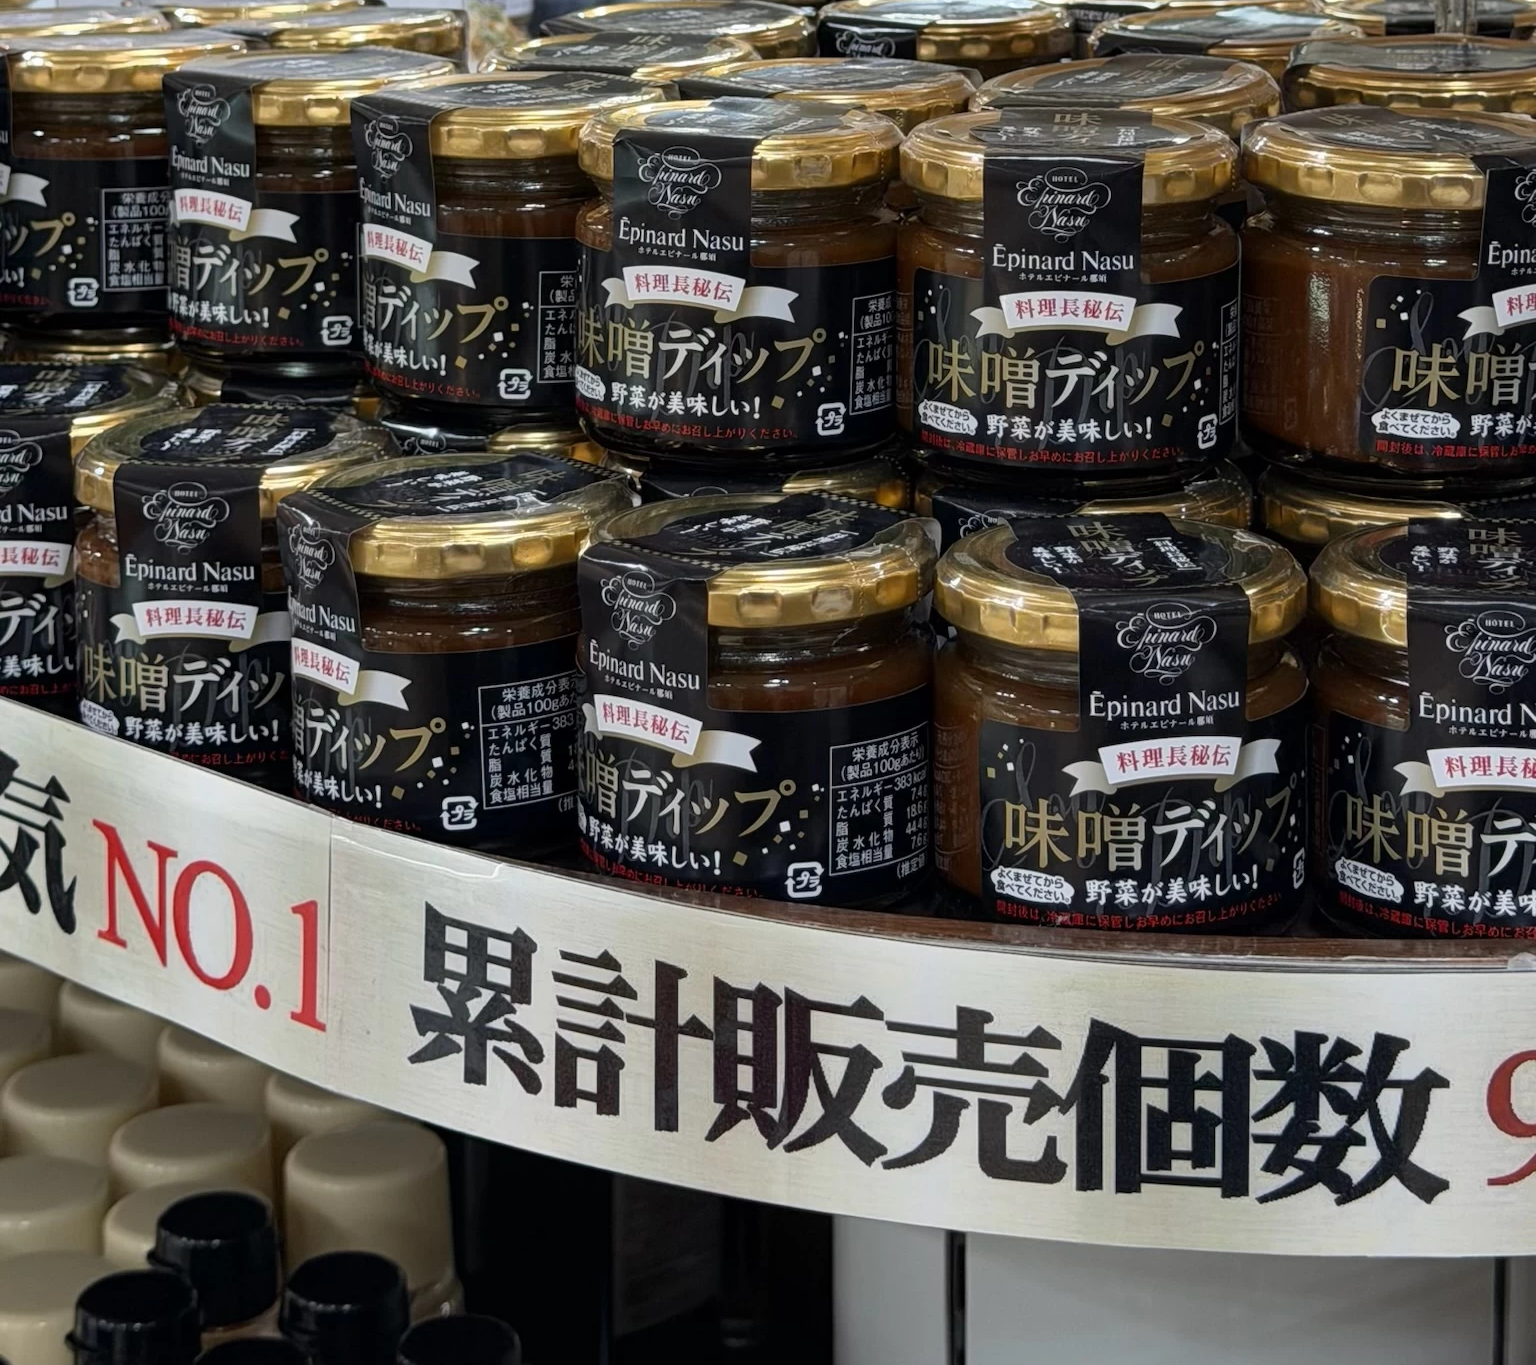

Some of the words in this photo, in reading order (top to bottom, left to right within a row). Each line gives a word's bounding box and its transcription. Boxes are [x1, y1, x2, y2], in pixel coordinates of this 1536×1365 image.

[211, 156, 250, 178] Nasu
[1051, 175, 1079, 184] HOTEL
[179, 195, 244, 223] 料理長秘伝
[394, 192, 431, 218] Nasu
[1028, 204, 1089, 232] Nasu
[367, 229, 425, 264] 料理長秘伝
[692, 229, 744, 252] Nasu
[1081, 250, 1134, 271] Nasu
[633, 272, 734, 303] 料理長秘伝
[1015, 298, 1125, 323] 料理長秘伝
[329, 324, 350, 339] プラ
[577, 310, 827, 385] 味噌ディップ
[507, 376, 529, 393] プラ
[928, 339, 1206, 410] 味噌ディップ
[1391, 342, 1536, 408] 味噌
[611, 381, 761, 420] 野菜が美味しい!
[824, 411, 844, 427] プラ
[986, 414, 1153, 444] 野菜が美味しい!
[1378, 421, 1456, 437] 食べてください。
[1380, 410, 1451, 425] よくまぜてから
[1470, 411, 1536, 438] 野菜が
[18, 503, 68, 524] Nasu
[203, 561, 255, 581] Nasu
[145, 606, 248, 630] 料理長秘伝
[319, 605, 356, 633] Nasu
[1153, 610, 1183, 621] HOTEL
[1485, 618, 1515, 628] HOTEL
[1130, 645, 1196, 673] Nasu
[1459, 651, 1529, 679] Nasu
[649, 662, 700, 691] Nasu
[1187, 689, 1240, 714] Nasu
[125, 716, 279, 746] 野菜が美味しい!
[488, 720, 551, 740] エネルギー
[552, 713, 574, 731] 383
[601, 701, 690, 745] 料理長秘伝
[489, 733, 552, 757] たんぱく質
[852, 731, 919, 763] 栄養成分表示
[1116, 742, 1232, 774] 料理長秘伝
[490, 765, 553, 788] 炭水化物
[490, 779, 553, 804] 食塩相当量
[837, 780, 893, 803] エネルギー
[451, 803, 475, 823] プラ
[837, 794, 893, 820] たんぱく質
[1004, 772, 1297, 872] 味噌ディップ
[588, 815, 721, 876] 野菜が美味しい!
[836, 828, 893, 854] 炭水化物
[835, 843, 893, 870] 食塩相当量
[796, 870, 822, 890] プラ
[997, 869, 1065, 889] よくまぜてから
[1085, 864, 1259, 906] 野菜が美味しい!
[995, 880, 1072, 905] 食べてください。
[93, 818, 328, 1032] NO.1
[407, 899, 1451, 1208] 累計販売個数
